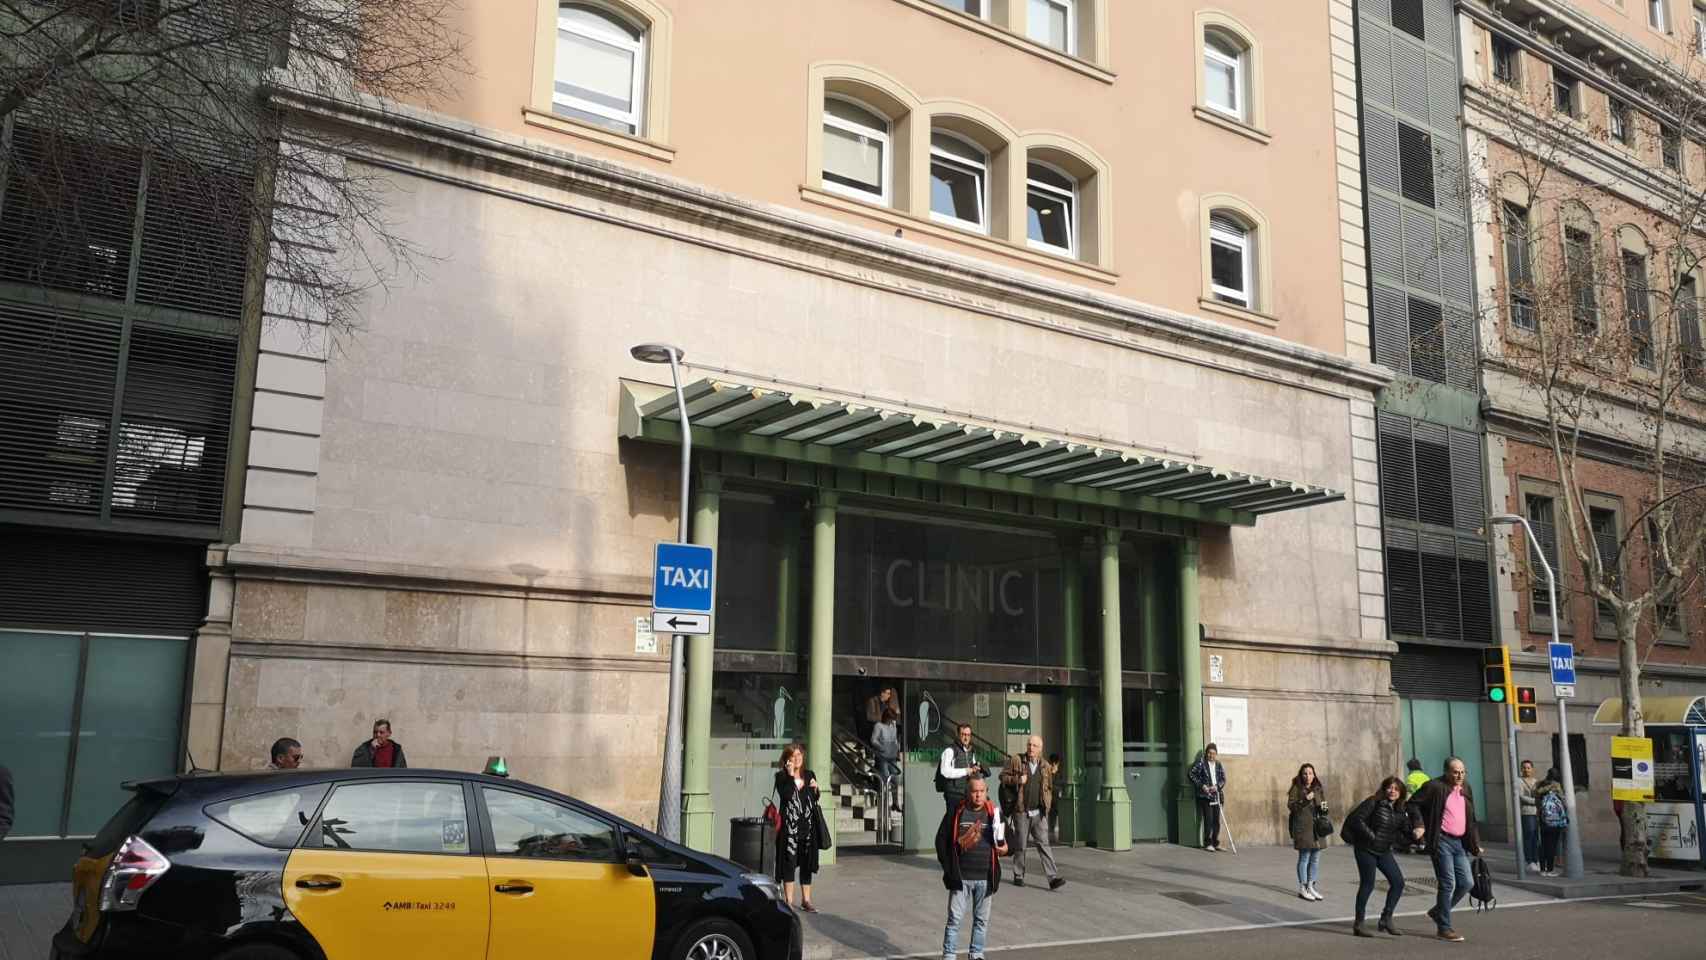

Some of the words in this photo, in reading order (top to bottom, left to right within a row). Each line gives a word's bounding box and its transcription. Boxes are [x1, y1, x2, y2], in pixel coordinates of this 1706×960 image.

[660, 566, 709, 589] TAXI
[886, 559, 1024, 616] CLINIC
[1552, 657, 1574, 670] TAXI
